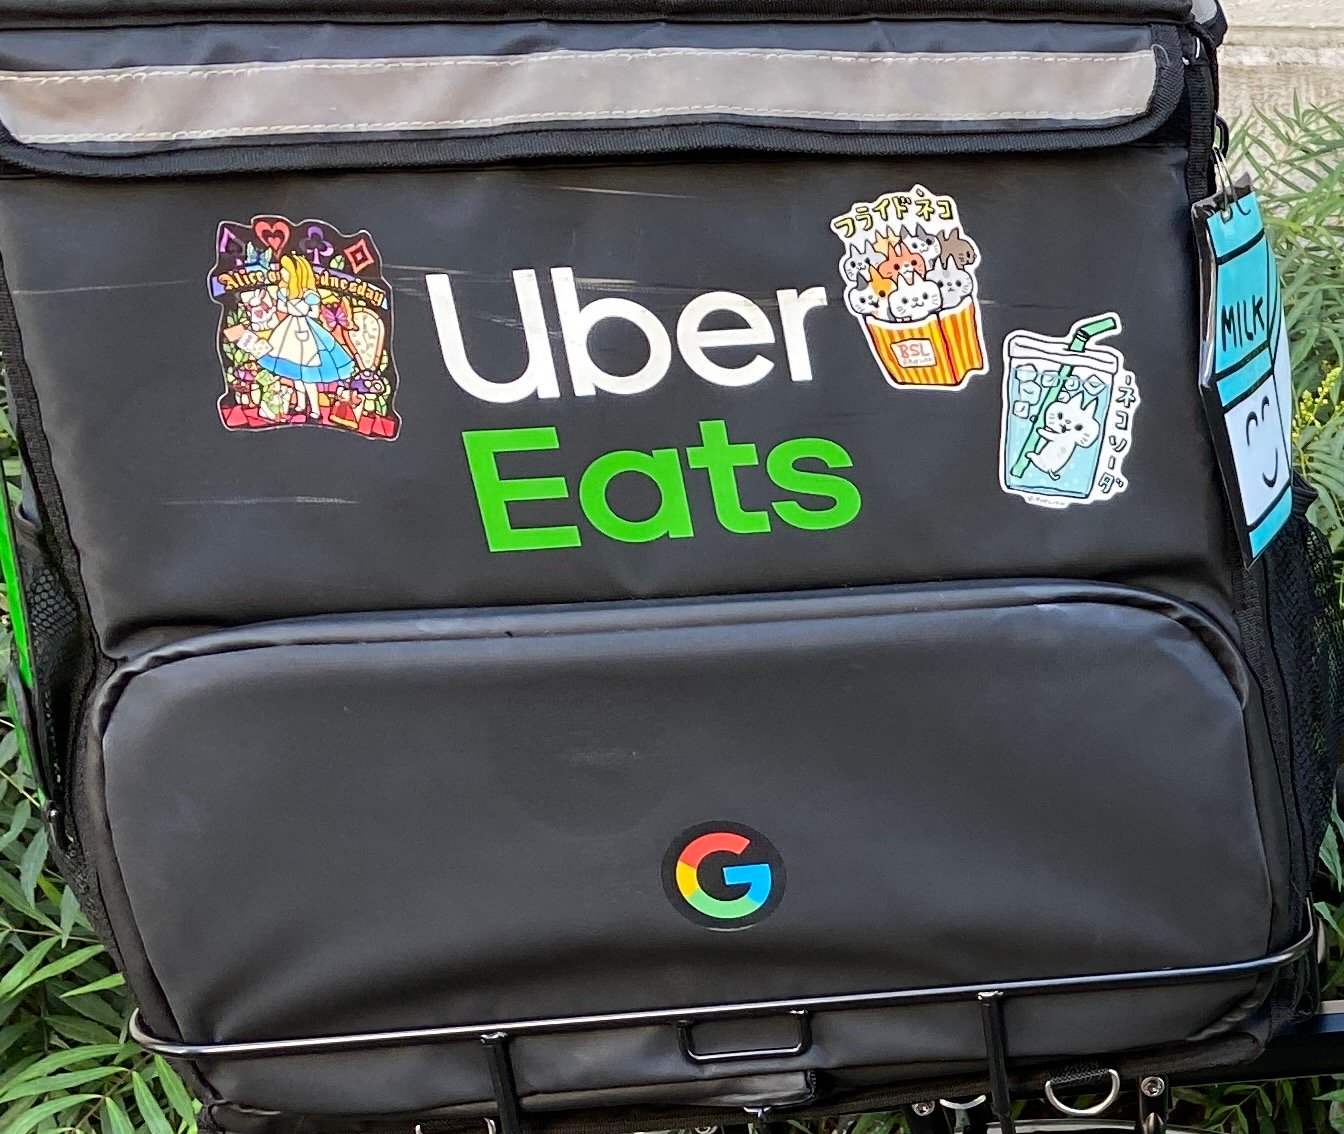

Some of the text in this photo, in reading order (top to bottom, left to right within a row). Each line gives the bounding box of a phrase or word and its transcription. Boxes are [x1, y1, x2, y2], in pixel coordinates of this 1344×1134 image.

[834, 188, 954, 238] フライドネコ
[218, 267, 265, 290] Alice
[315, 271, 385, 306] ednesday
[426, 267, 828, 403] Uber
[898, 343, 931, 359] BSL
[1221, 294, 1265, 352] MILK
[1099, 375, 1137, 493] ネコソーダ
[462, 420, 861, 552] Eats
[676, 832, 772, 919] G
